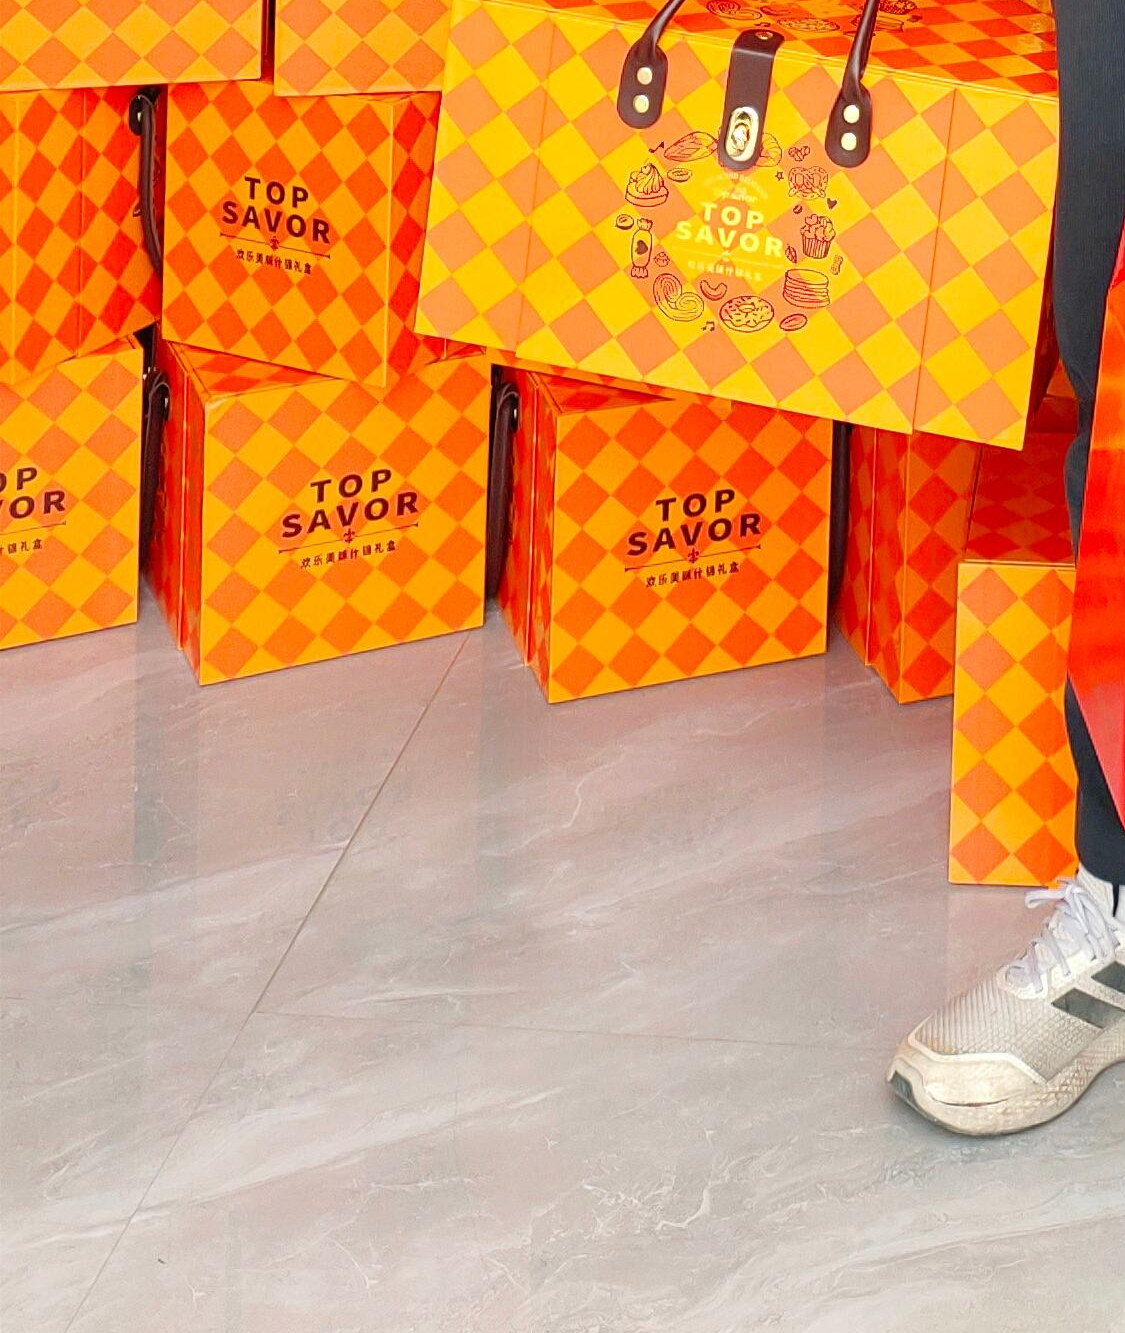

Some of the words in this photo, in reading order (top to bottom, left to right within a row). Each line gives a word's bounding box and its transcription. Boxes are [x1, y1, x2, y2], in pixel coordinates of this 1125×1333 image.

[244, 176, 309, 209] TOP
[221, 200, 331, 245] SAVOR
[701, 200, 765, 230] TOP
[676, 220, 784, 257] SAVOR
[310, 469, 392, 504] TOP
[281, 491, 419, 539] SAVOR
[655, 488, 736, 523] TOP
[626, 513, 762, 557] SAVOR
